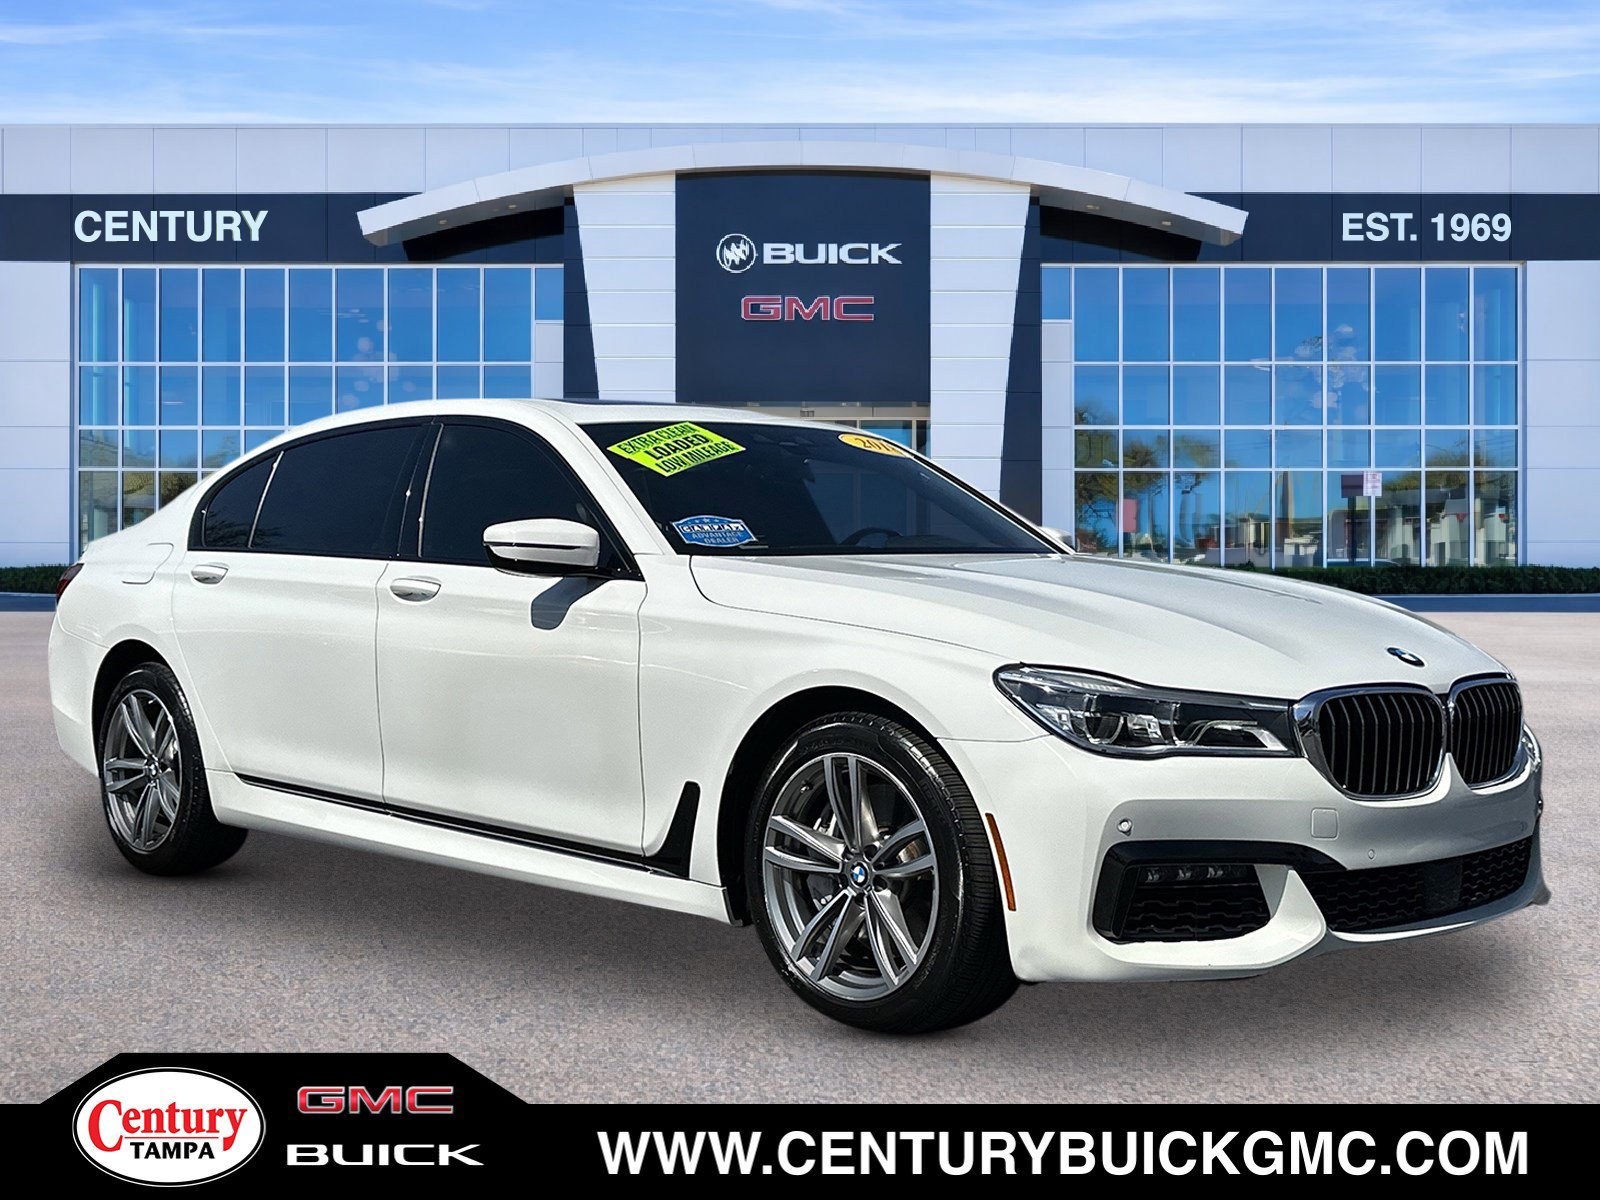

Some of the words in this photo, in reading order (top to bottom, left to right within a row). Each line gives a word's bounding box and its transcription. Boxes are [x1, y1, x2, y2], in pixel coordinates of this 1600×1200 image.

[74, 210, 269, 243] CENTURY
[1342, 212, 1417, 242] EST.
[1431, 212, 1512, 242] 1969
[763, 243, 902, 264] BUICK
[741, 295, 875, 321] GMC
[616, 433, 661, 455] EXTRA
[656, 424, 697, 442] CLEAN
[644, 434, 710, 460] LOADED
[655, 456, 687, 473] LOW
[682, 441, 735, 464] MILEAGE
[691, 531, 743, 539] ADVANTAGE
